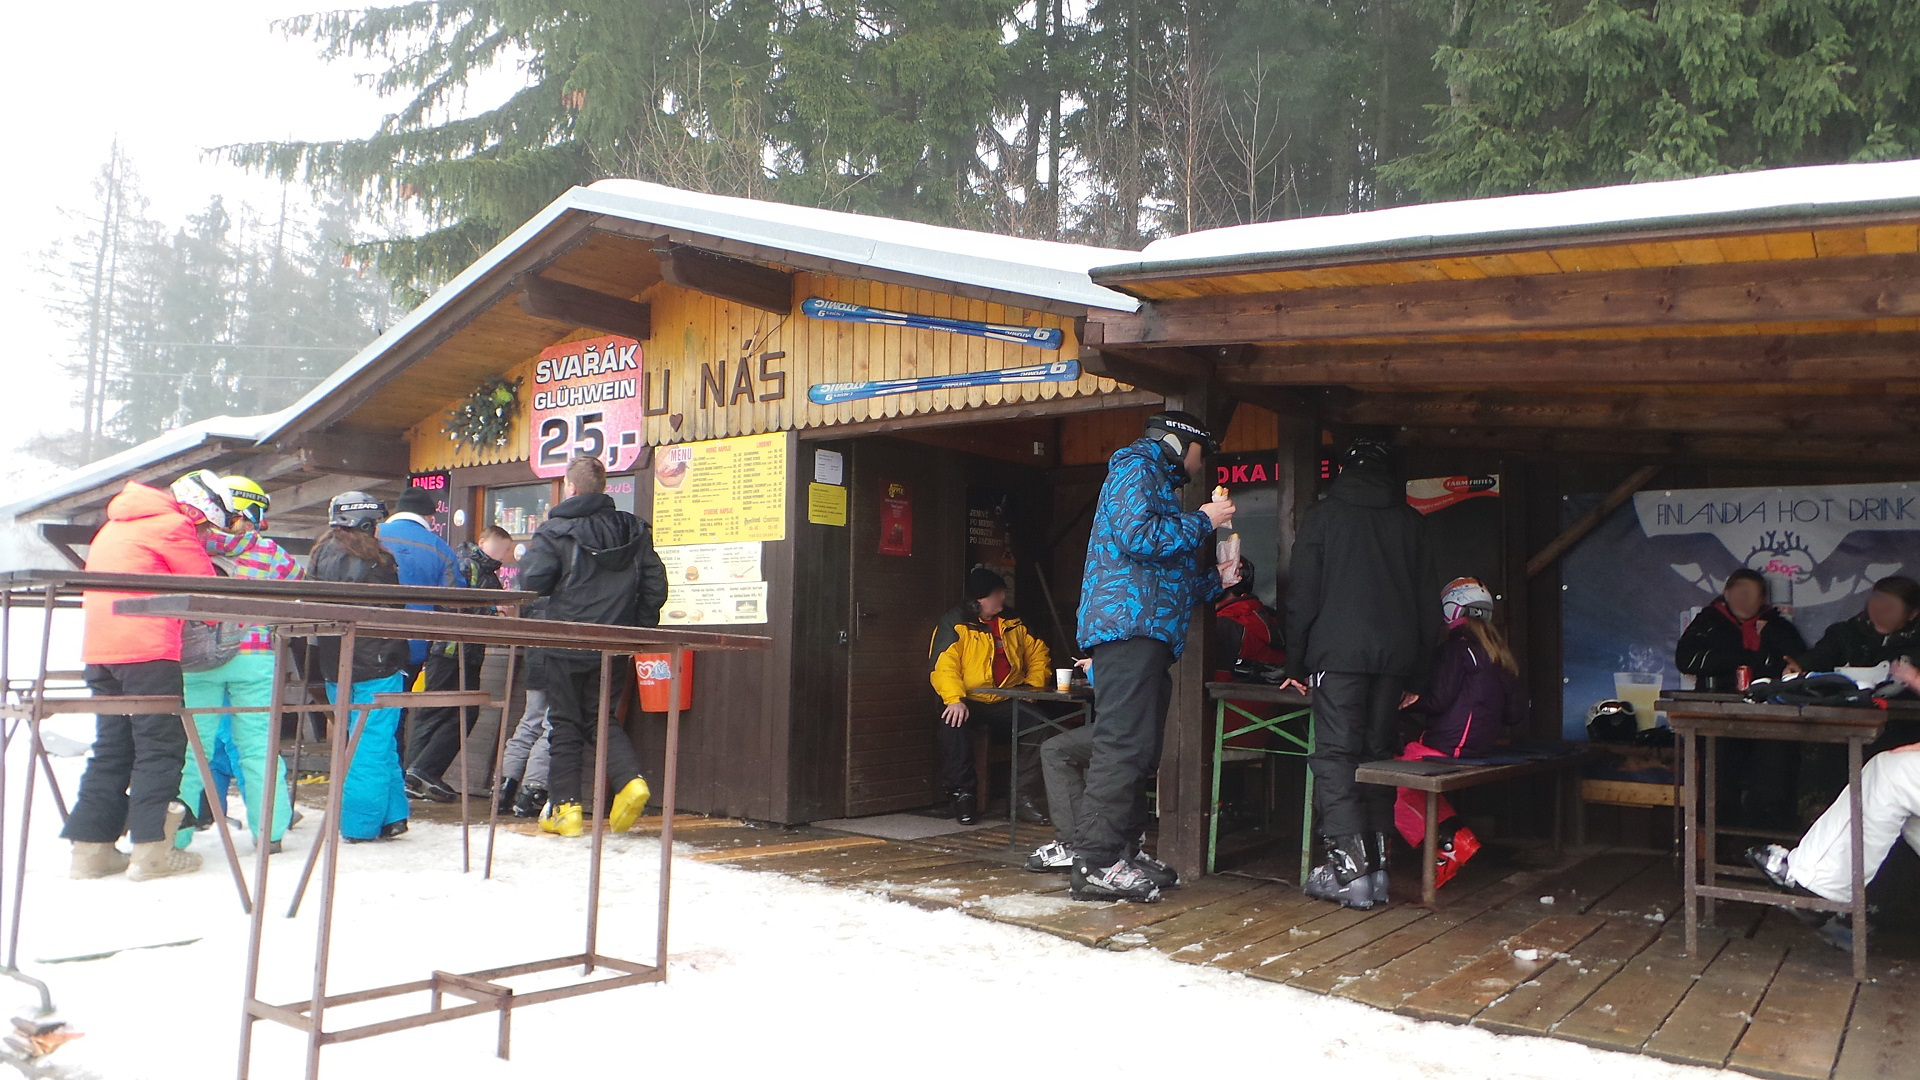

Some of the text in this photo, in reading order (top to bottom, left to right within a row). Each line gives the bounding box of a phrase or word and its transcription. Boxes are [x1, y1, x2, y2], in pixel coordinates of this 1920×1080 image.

[814, 299, 861, 312] ATOMIC
[536, 344, 638, 384] SVAŘÁK
[644, 340, 785, 417] U NÁS
[820, 381, 868, 393] ATOMIC
[534, 378, 636, 411] GLÜHWEIN
[671, 447, 692, 462] MENU
[1217, 463, 1267, 484] DKA
[340, 503, 379, 511] BLIZZARD
[1657, 497, 1917, 526] FINLANDIA HOT DRINK
